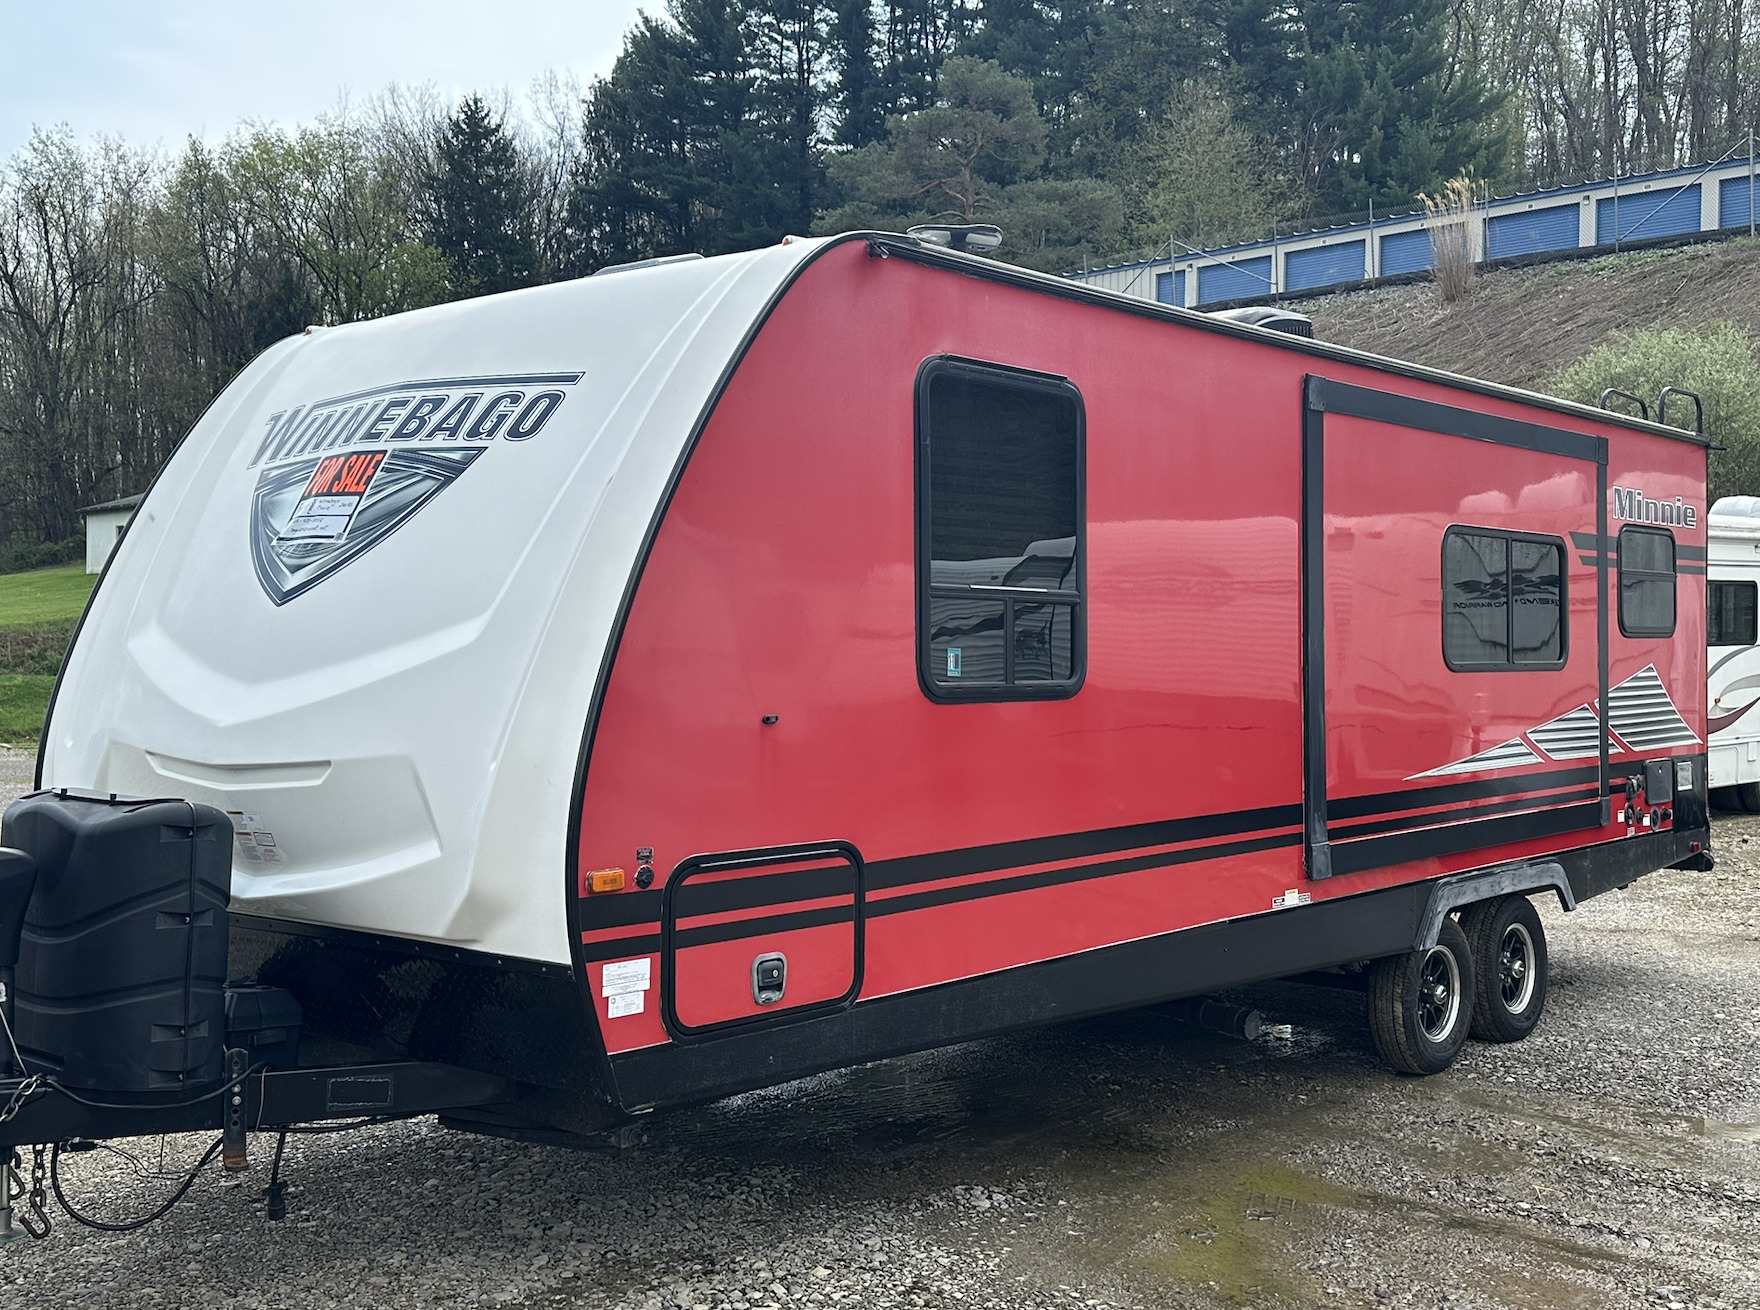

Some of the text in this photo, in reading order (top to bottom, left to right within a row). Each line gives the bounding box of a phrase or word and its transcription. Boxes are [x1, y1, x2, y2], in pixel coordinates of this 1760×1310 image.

[247, 390, 566, 470] WINNEBAGO
[304, 454, 384, 496] FOR SALE
[1612, 485, 1697, 529] Minnie
